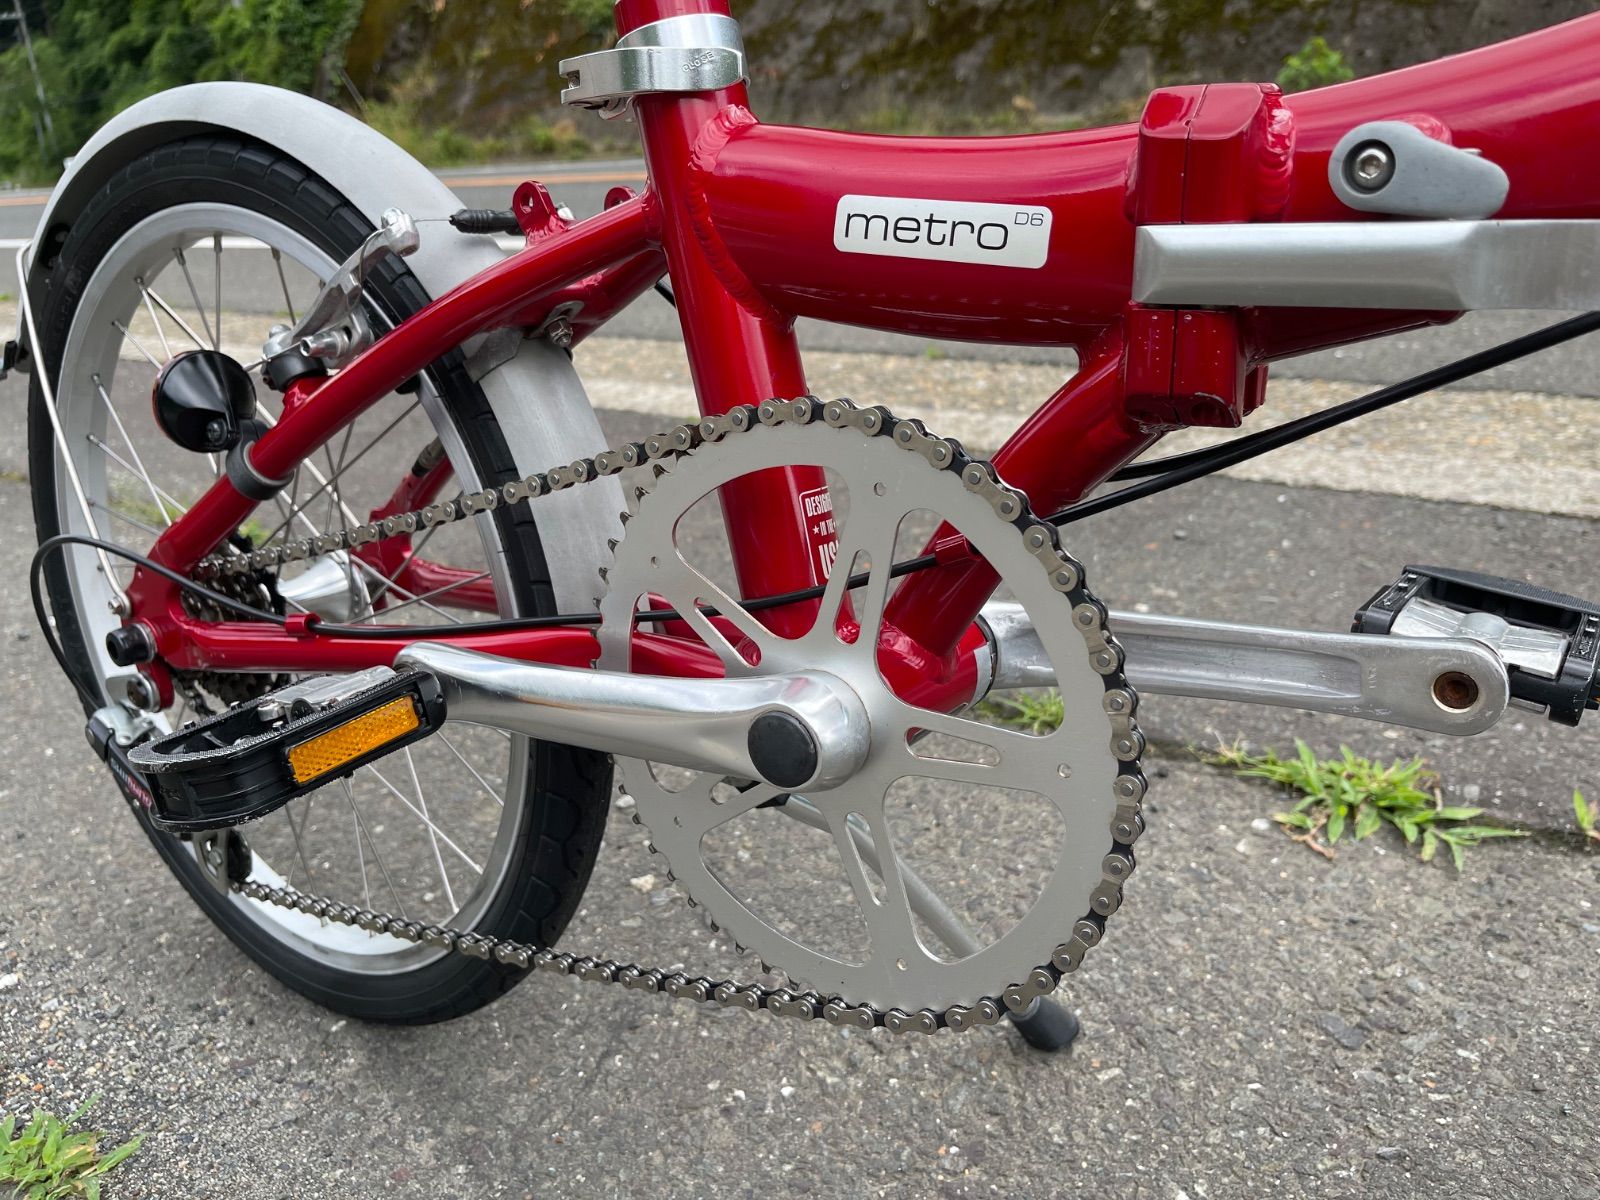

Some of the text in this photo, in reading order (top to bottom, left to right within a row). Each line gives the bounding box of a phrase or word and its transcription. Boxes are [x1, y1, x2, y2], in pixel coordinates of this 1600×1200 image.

[682, 51, 714, 72] CLOSE
[844, 211, 1044, 251] metro D6
[819, 540, 839, 580] US
